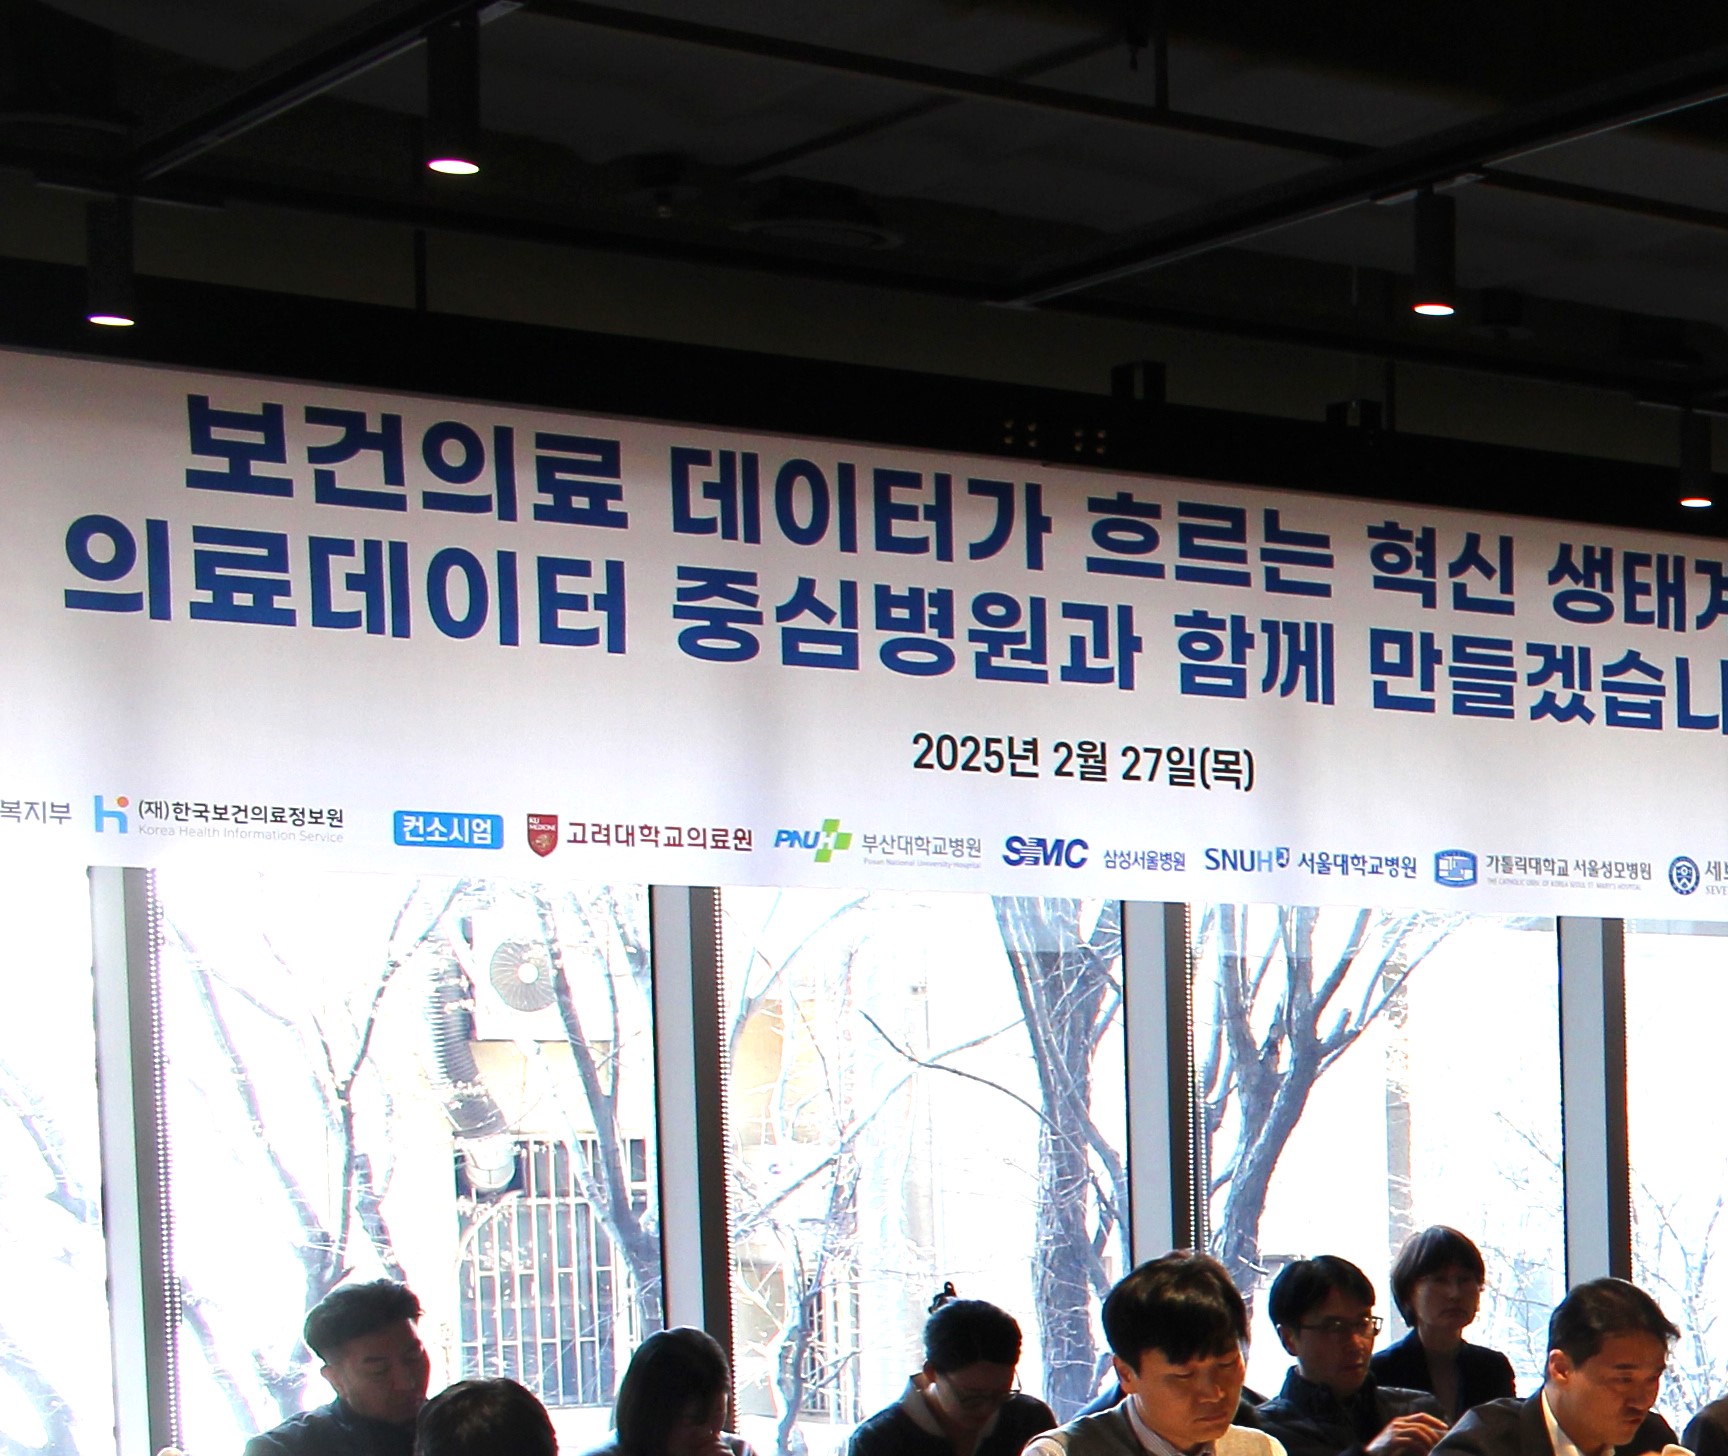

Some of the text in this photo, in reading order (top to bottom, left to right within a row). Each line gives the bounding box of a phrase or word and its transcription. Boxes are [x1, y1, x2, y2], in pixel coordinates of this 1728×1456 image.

[185, 392, 630, 530] 보건의료
[666, 442, 1053, 571] 데이터가
[1086, 488, 1334, 599] 흐르는
[1367, 520, 1515, 616] 혁신
[65, 514, 626, 654] 의료데이터
[672, 565, 1143, 692] 중심병원과
[1174, 606, 1335, 705] 함께
[912, 732, 1254, 792] 2025년 2월 27일(목)
[138, 799, 344, 828] (재)한국보건의료정보원
[138, 824, 344, 843] Korea Health Information Service
[402, 815, 493, 845] 컨소시엄
[566, 822, 754, 851] 고려대학교의료원
[861, 834, 981, 858] 부산대학교병원
[1103, 849, 1186, 872] 삼성서울병원
[1298, 851, 1417, 879] 서울대학교병원
[1486, 855, 1652, 880] 가톨릭대학교 서울성모병원
